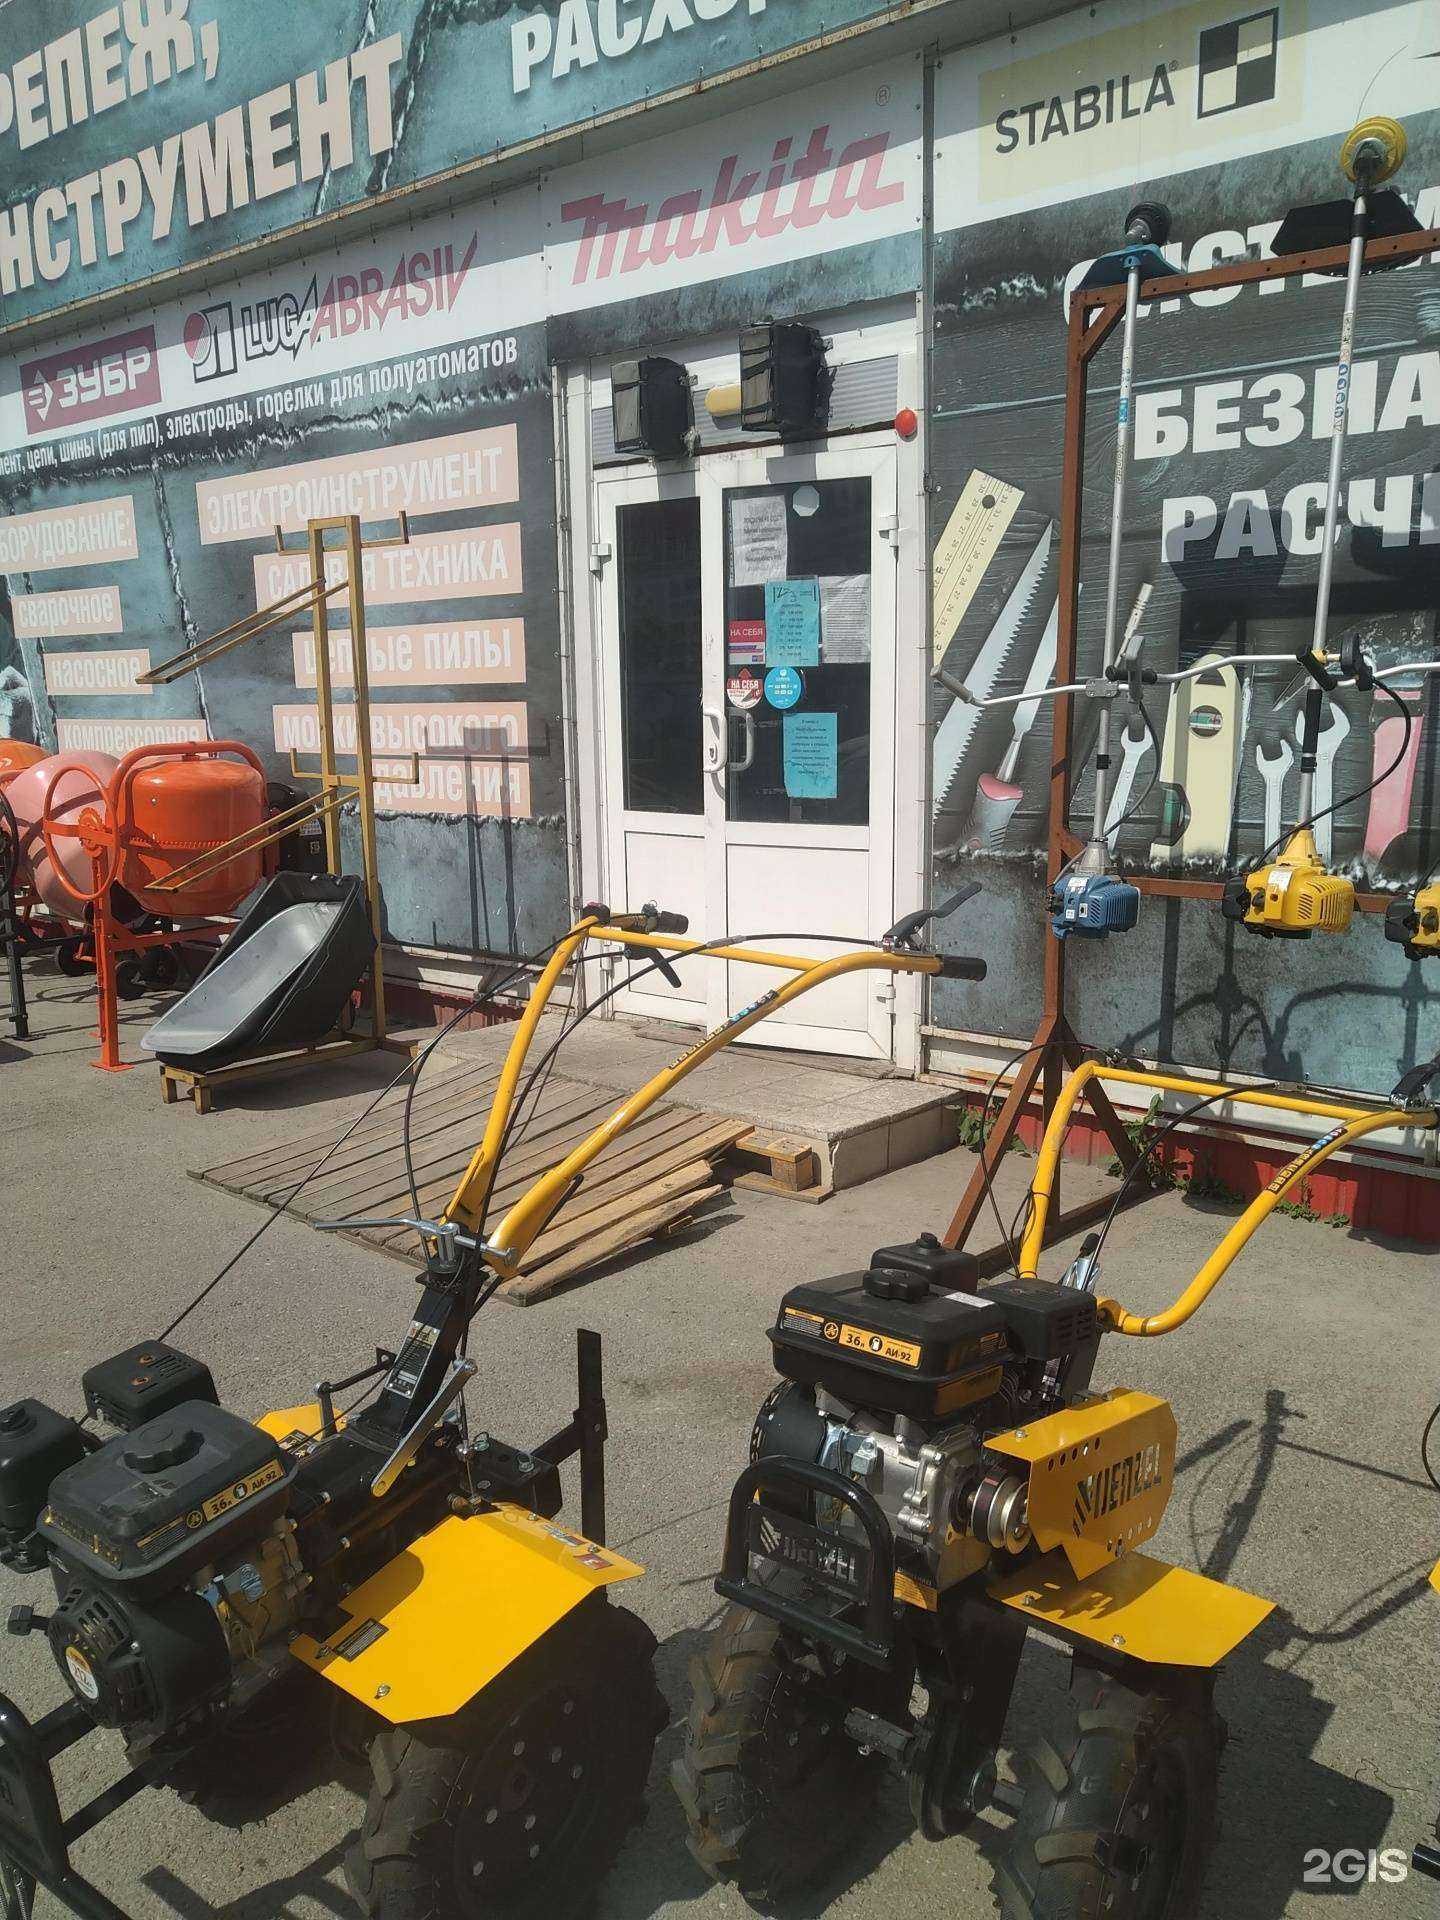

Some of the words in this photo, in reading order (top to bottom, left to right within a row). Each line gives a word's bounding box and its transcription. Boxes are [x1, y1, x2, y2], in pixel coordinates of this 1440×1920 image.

[27, 446, 58, 472] цепи,
[59, 436, 95, 462] шины
[97, 428, 127, 460] (для
[129, 416, 164, 448] пил),
[166, 400, 253, 440] электроды,
[255, 385, 324, 422] горелки
[330, 376, 364, 408] для
[369, 336, 518, 394] полуатоматов
[56, 345, 152, 408] ЗУБР
[206, 446, 503, 535] ЭЛЕКТРОИНСТРУМЕНТ
[382, 538, 509, 592] ТЕХНИКА
[17, 592, 114, 632] сварочное
[423, 628, 511, 670] пилы
